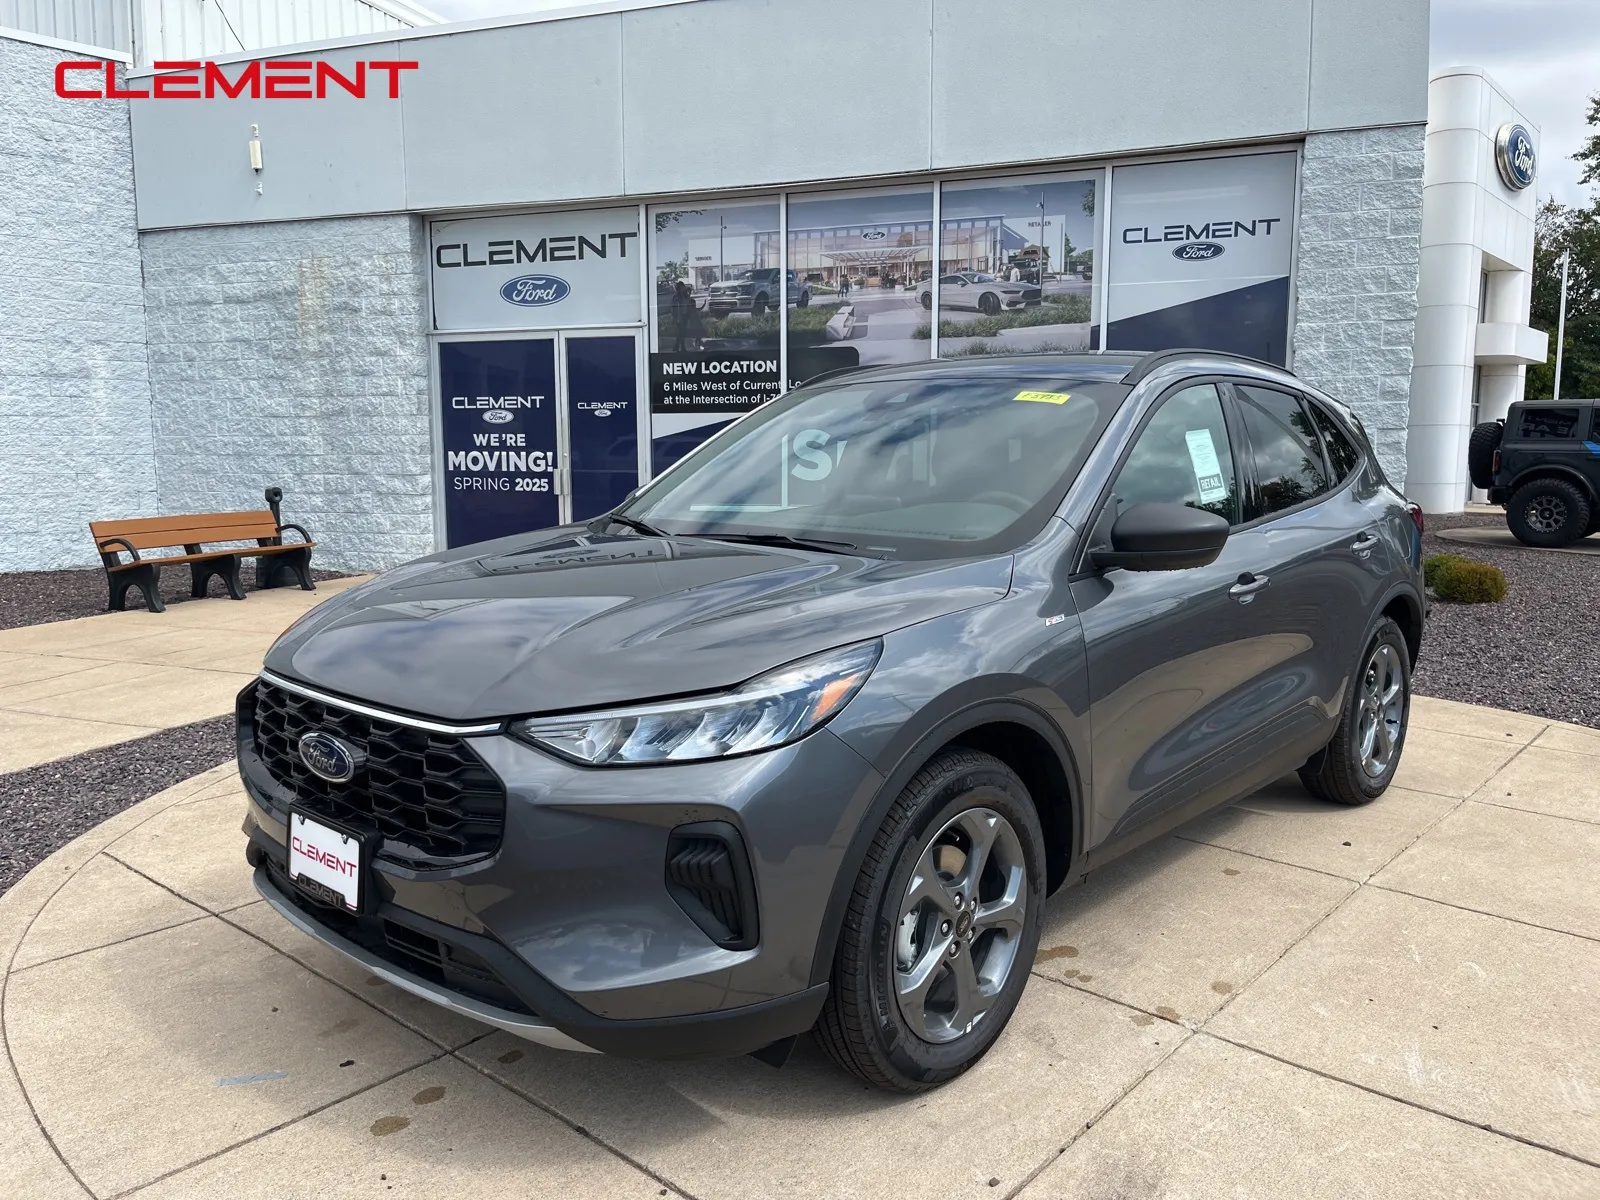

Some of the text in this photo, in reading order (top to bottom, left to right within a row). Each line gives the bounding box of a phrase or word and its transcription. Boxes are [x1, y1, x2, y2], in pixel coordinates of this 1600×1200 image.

[1122, 218, 1281, 244] CLEMENT
[436, 232, 638, 268] CLEMENT
[662, 359, 777, 375] NEW LOCATION
[663, 379, 802, 391] 6 Miles West of Current Lo
[452, 395, 545, 409] CLEMENT
[577, 401, 628, 410] CLEMENT
[663, 396, 673, 405] at
[674, 395, 691, 404] the
[692, 394, 748, 404] Intersection
[750, 393, 761, 403] of
[473, 433, 527, 447] WE'RE
[447, 450, 554, 472] MOVING!
[453, 477, 549, 492] SPRING 2025
[1200, 476, 1222, 490] RETAIL
[292, 836, 357, 877] CLEMENT
[298, 875, 344, 905] CLEMENT
